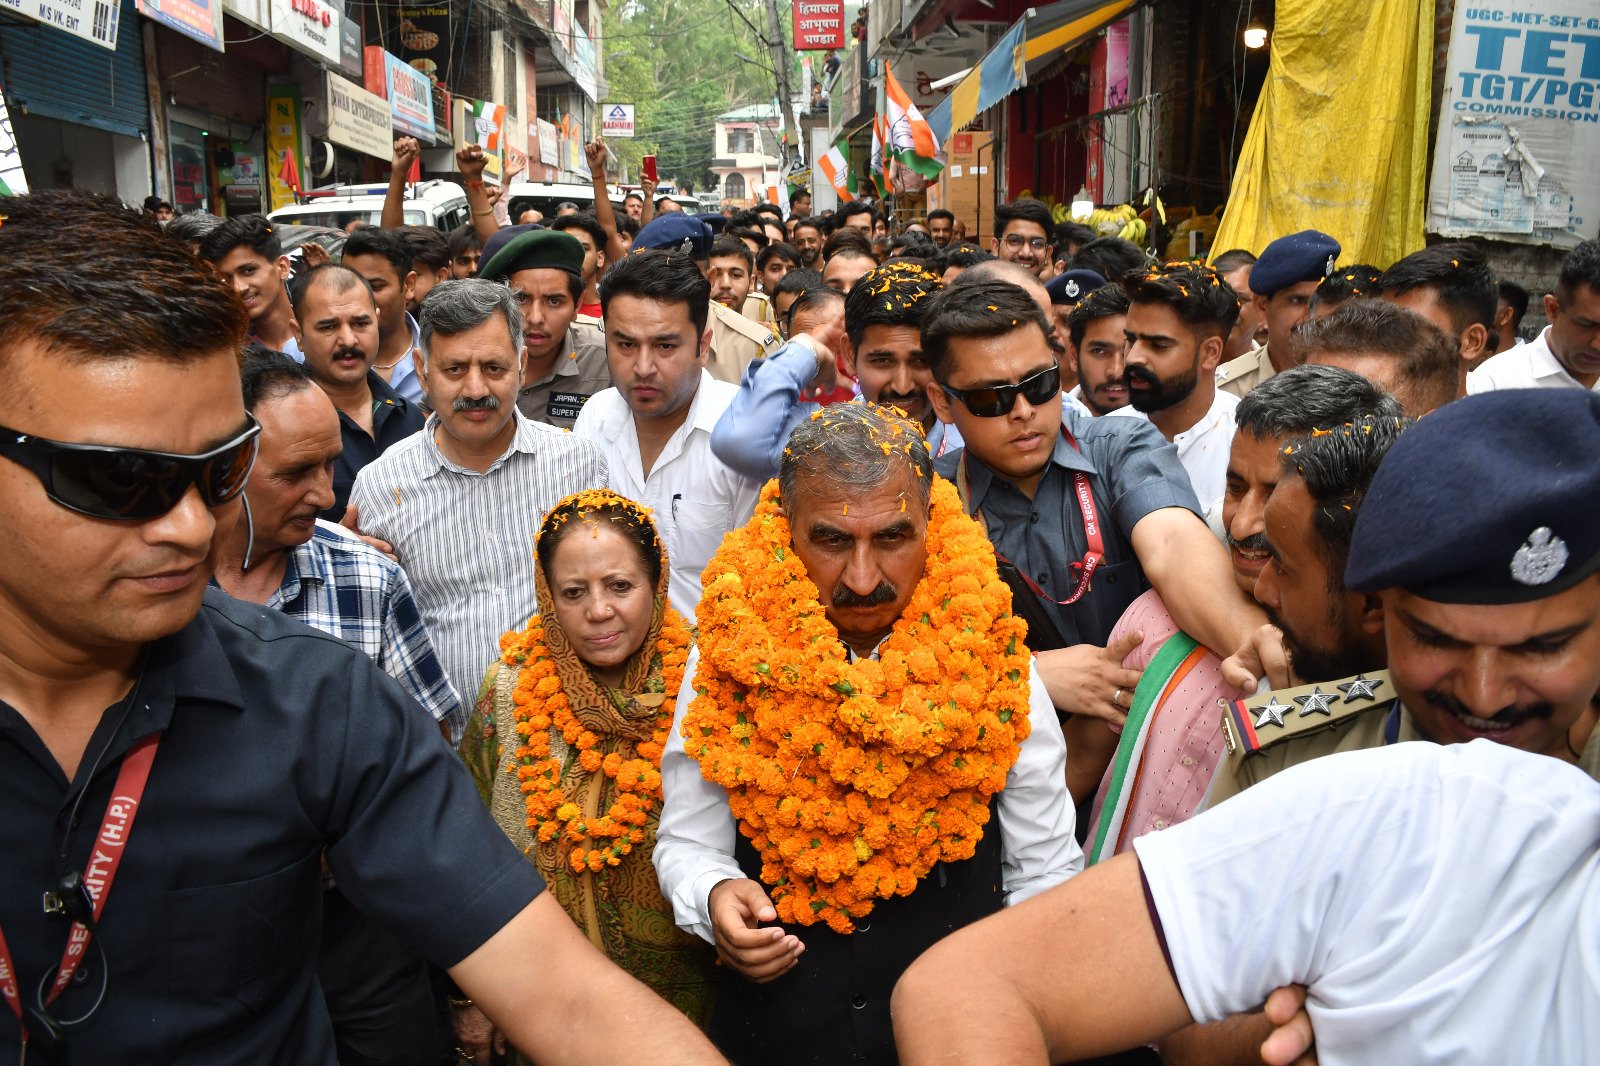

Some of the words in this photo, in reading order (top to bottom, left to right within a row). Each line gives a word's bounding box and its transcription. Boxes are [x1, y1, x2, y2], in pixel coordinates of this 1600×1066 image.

[426, 7, 448, 16] Pizza
[799, 2, 839, 15] हिमाचल
[39, 3, 46, 18] M
[46, 7, 52, 20] S
[66, 15, 79, 31] ENT
[1465, 8, 1600, 30] UGC-NET-SET-G
[800, 19, 839, 32] आभूषण
[804, 34, 836, 44] भण्डार
[1458, 72, 1600, 108] TGT/PG
[1453, 101, 1599, 123] COMMISSION
[551, 408, 574, 417] SUPER
[1077, 481, 1093, 521] SECURITY
[1088, 521, 1097, 536] CM
[1084, 556, 1096, 571] CM
[100, 796, 137, 847] (H.P.)
